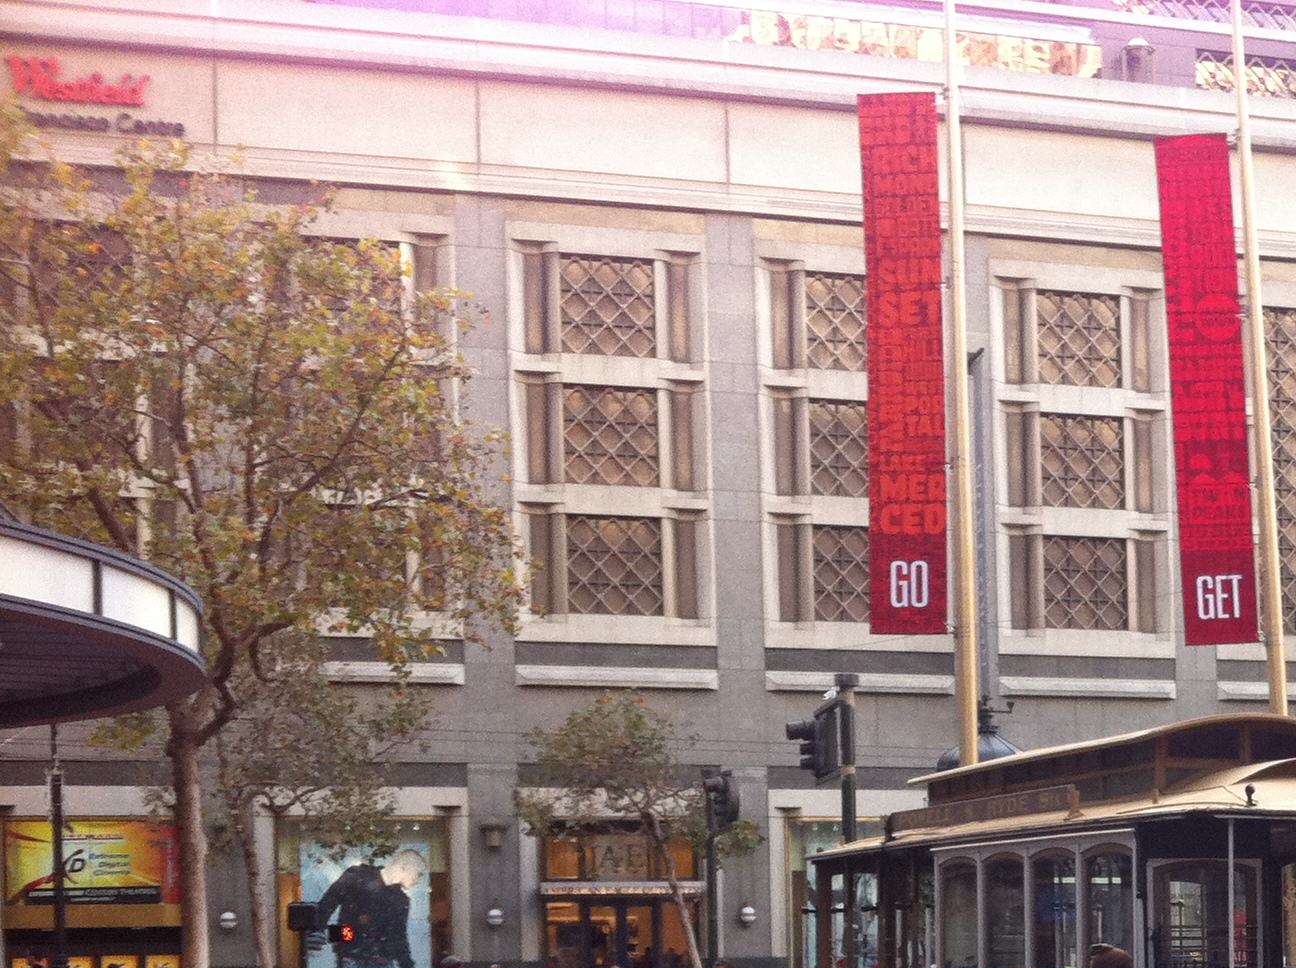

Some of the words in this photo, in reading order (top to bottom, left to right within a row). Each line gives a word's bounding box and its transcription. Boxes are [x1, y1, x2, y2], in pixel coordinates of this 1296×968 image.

[878, 290, 941, 328] SET
[890, 560, 930, 608] GO
[1196, 574, 1243, 620] GET
